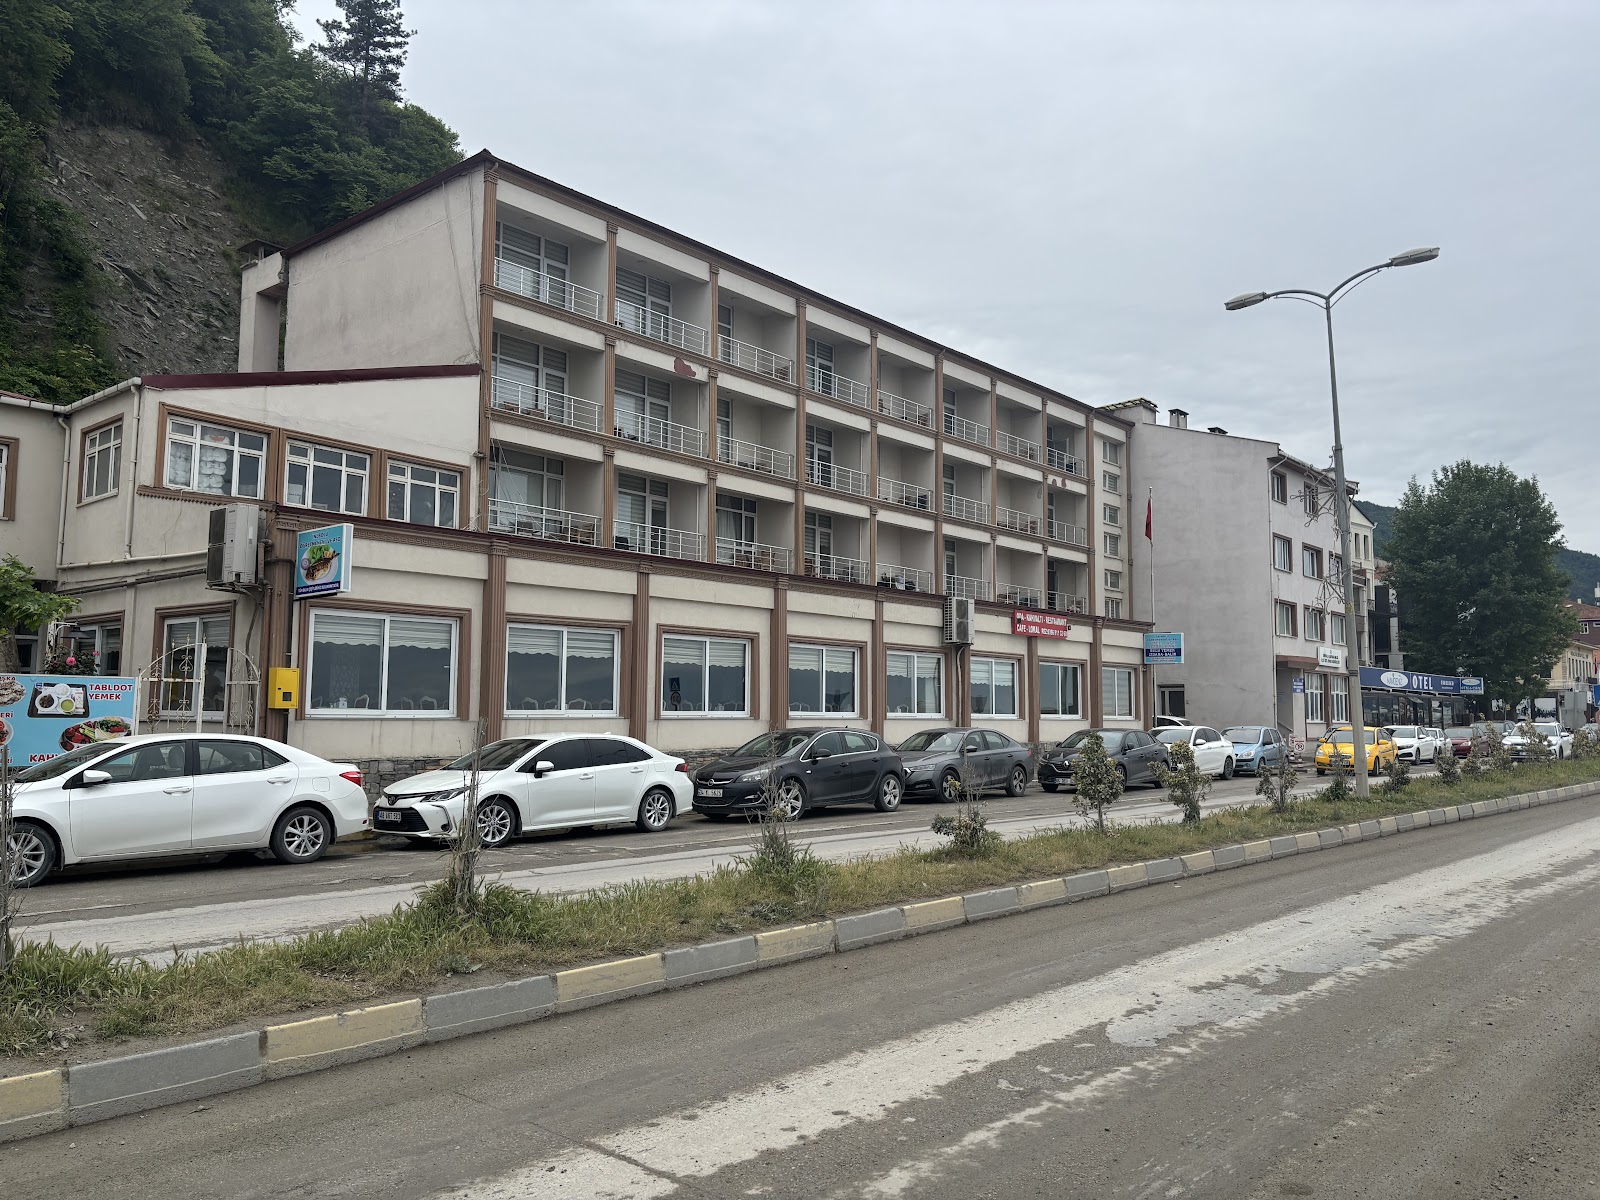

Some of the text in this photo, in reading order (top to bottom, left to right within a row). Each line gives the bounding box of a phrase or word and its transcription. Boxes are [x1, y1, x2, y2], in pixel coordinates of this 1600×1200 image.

[1016, 624, 1027, 632] CAFE
[1412, 675, 1434, 690] OTEL
[89, 684, 133, 692] TABLDOT
